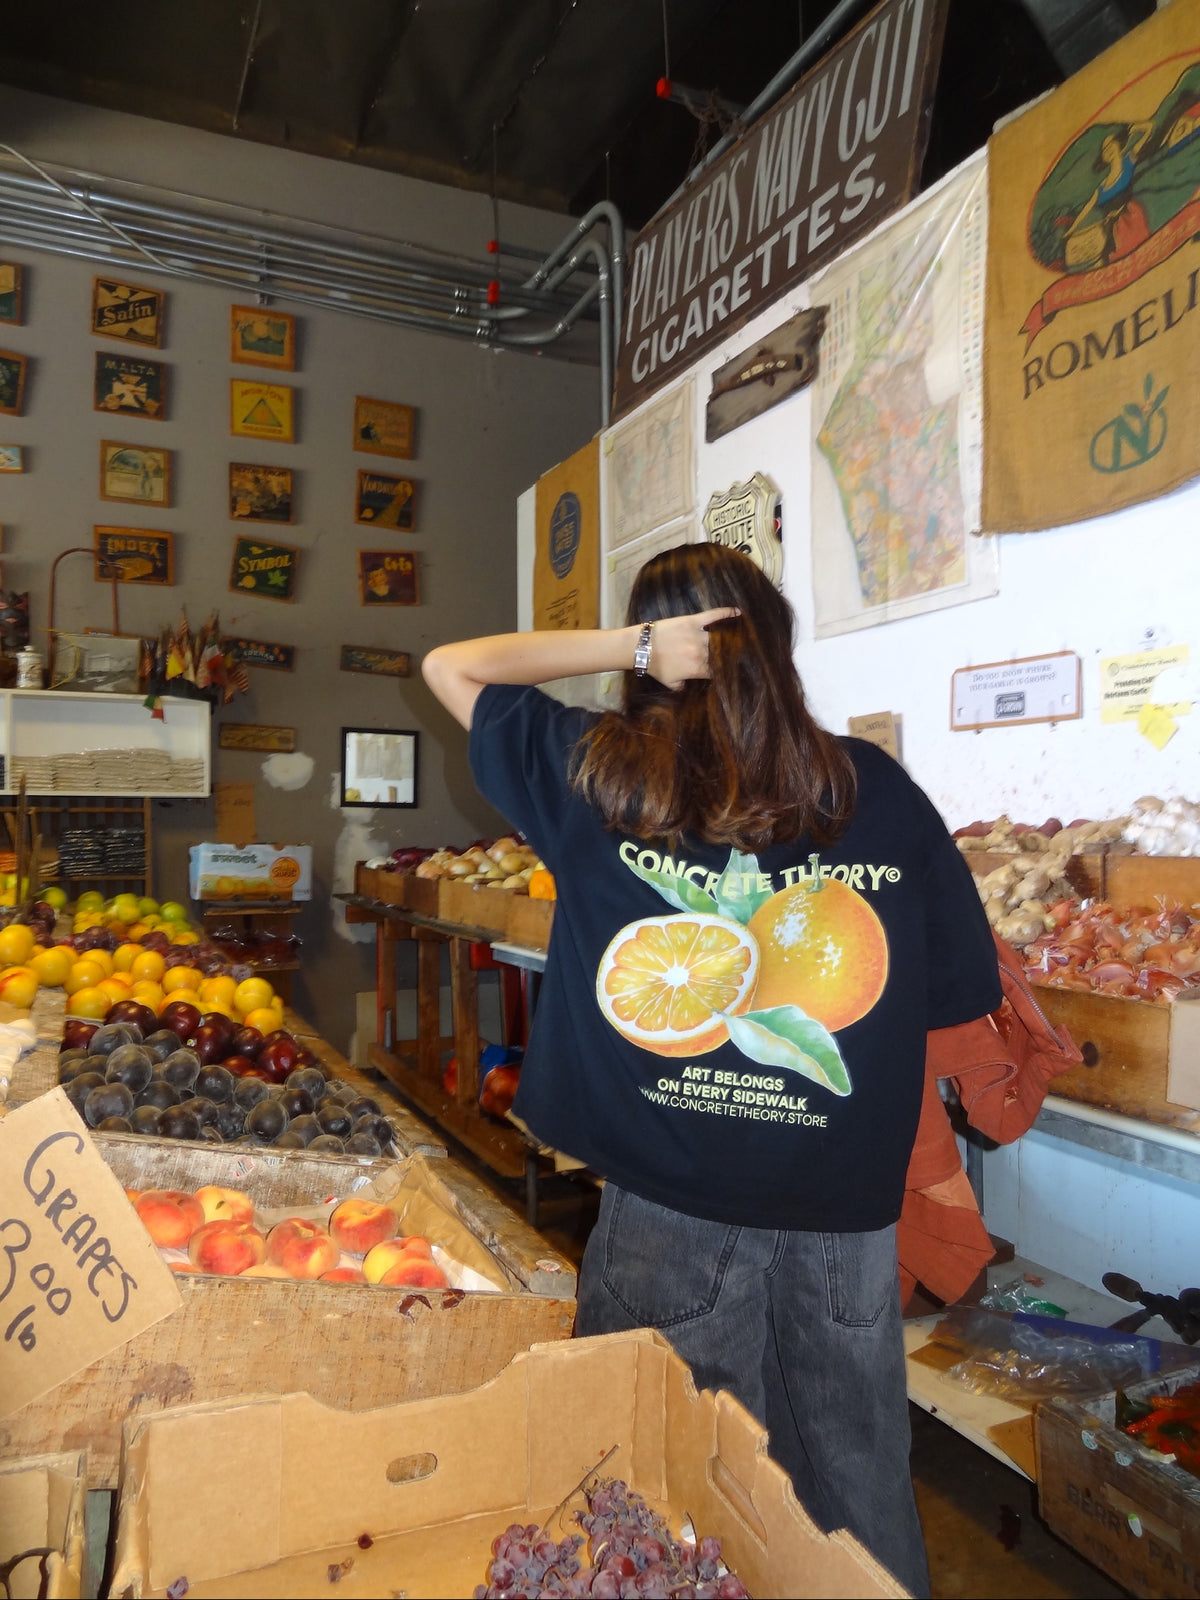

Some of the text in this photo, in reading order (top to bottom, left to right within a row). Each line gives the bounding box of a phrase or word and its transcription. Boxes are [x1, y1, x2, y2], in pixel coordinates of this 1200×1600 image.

[626, 147, 749, 345] PLAYER'S
[745, 58, 844, 245] NAVY
[631, 152, 887, 384] CIGARETTES.
[101, 303, 153, 326] Satin
[105, 360, 156, 377] MALTA
[712, 499, 751, 526] HISTORIC
[107, 537, 160, 559] INDEX
[681, 1065, 785, 1092] ART BELONGS
[657, 1077, 809, 1112] ON EVERY SIDEWALK
